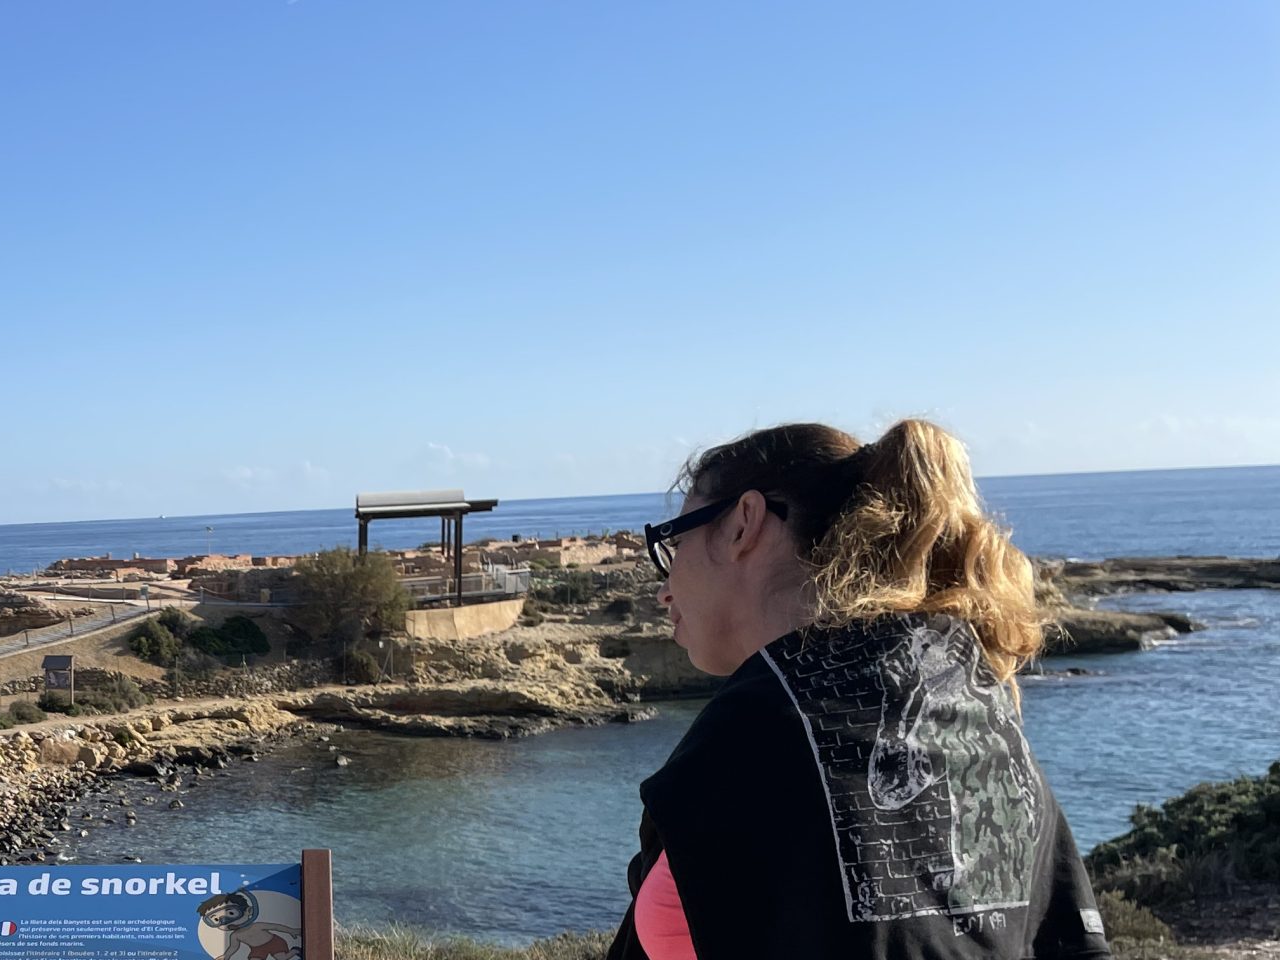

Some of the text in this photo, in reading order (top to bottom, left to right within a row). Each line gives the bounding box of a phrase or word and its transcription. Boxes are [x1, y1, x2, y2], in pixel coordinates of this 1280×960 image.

[27, 873, 72, 896] de
[80, 872, 222, 896] snorkel
[951, 912, 985, 937] EST
